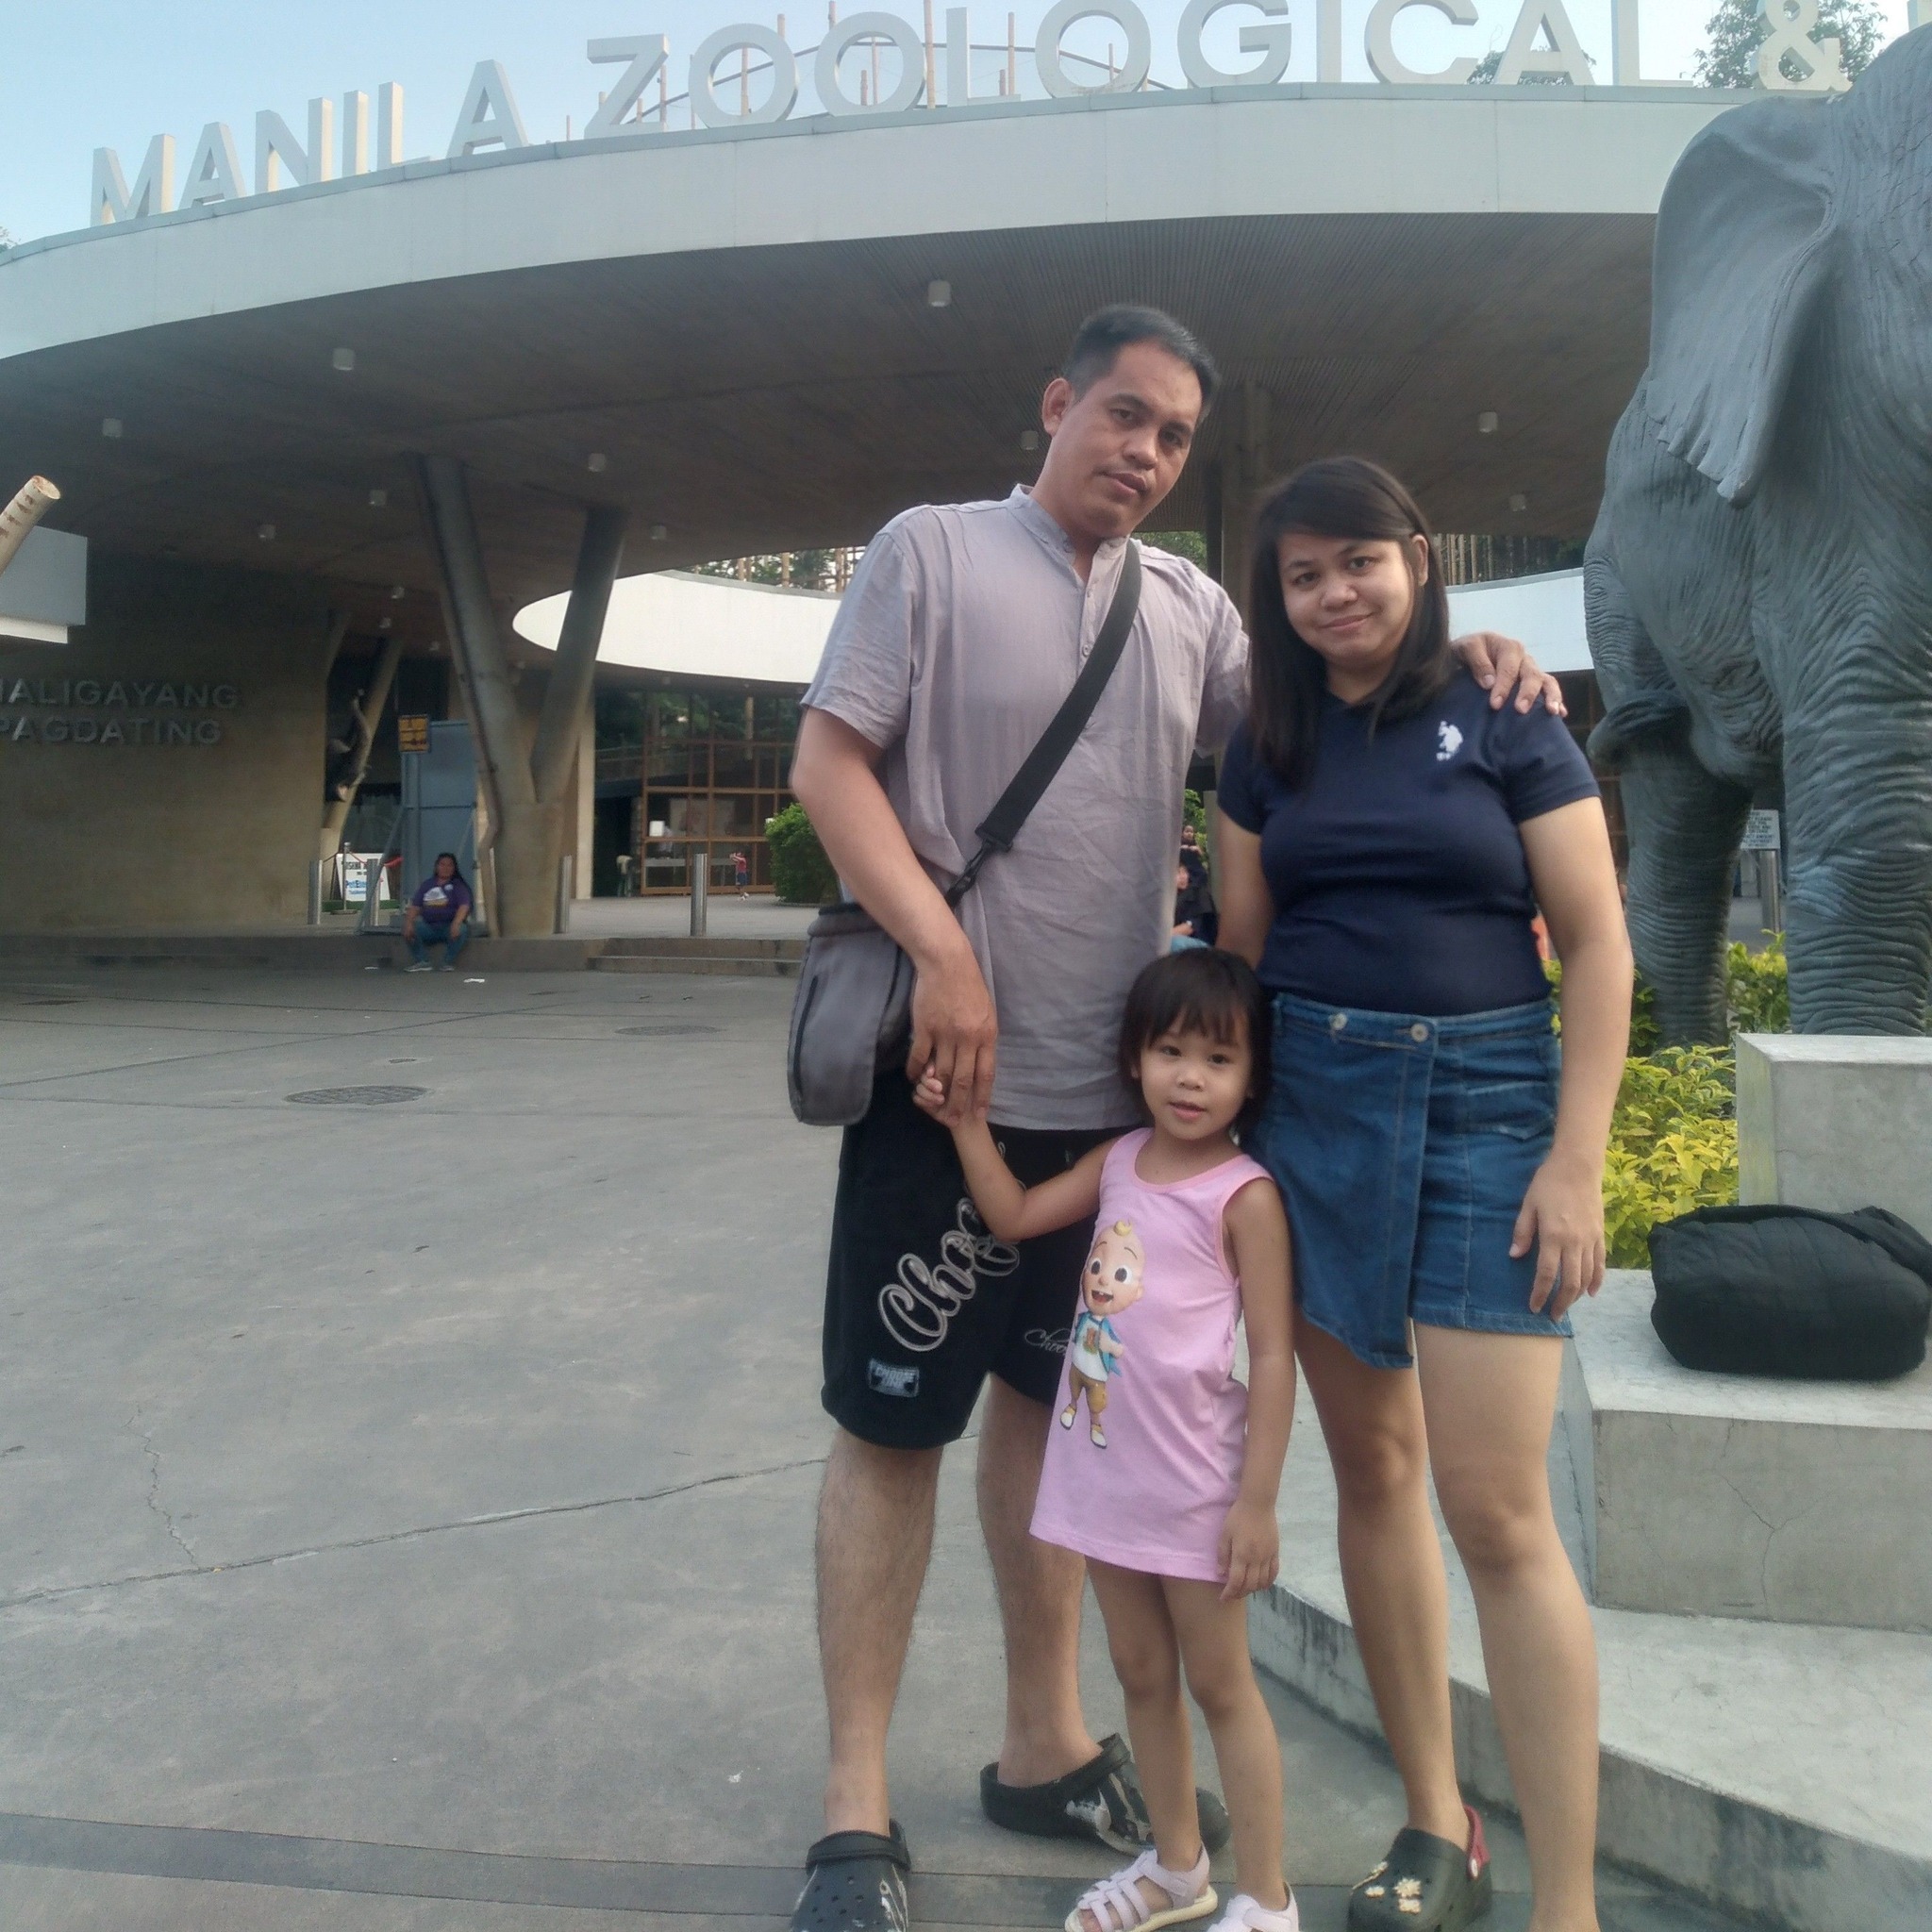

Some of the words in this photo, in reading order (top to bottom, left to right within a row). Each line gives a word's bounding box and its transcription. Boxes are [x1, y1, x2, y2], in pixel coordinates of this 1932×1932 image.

[91, 58, 531, 227] MANILA
[583, 0, 1694, 140] ZOOLOGICAL
[1749, 0, 1854, 92] &
[0, 678, 239, 708] ALIGAYANG
